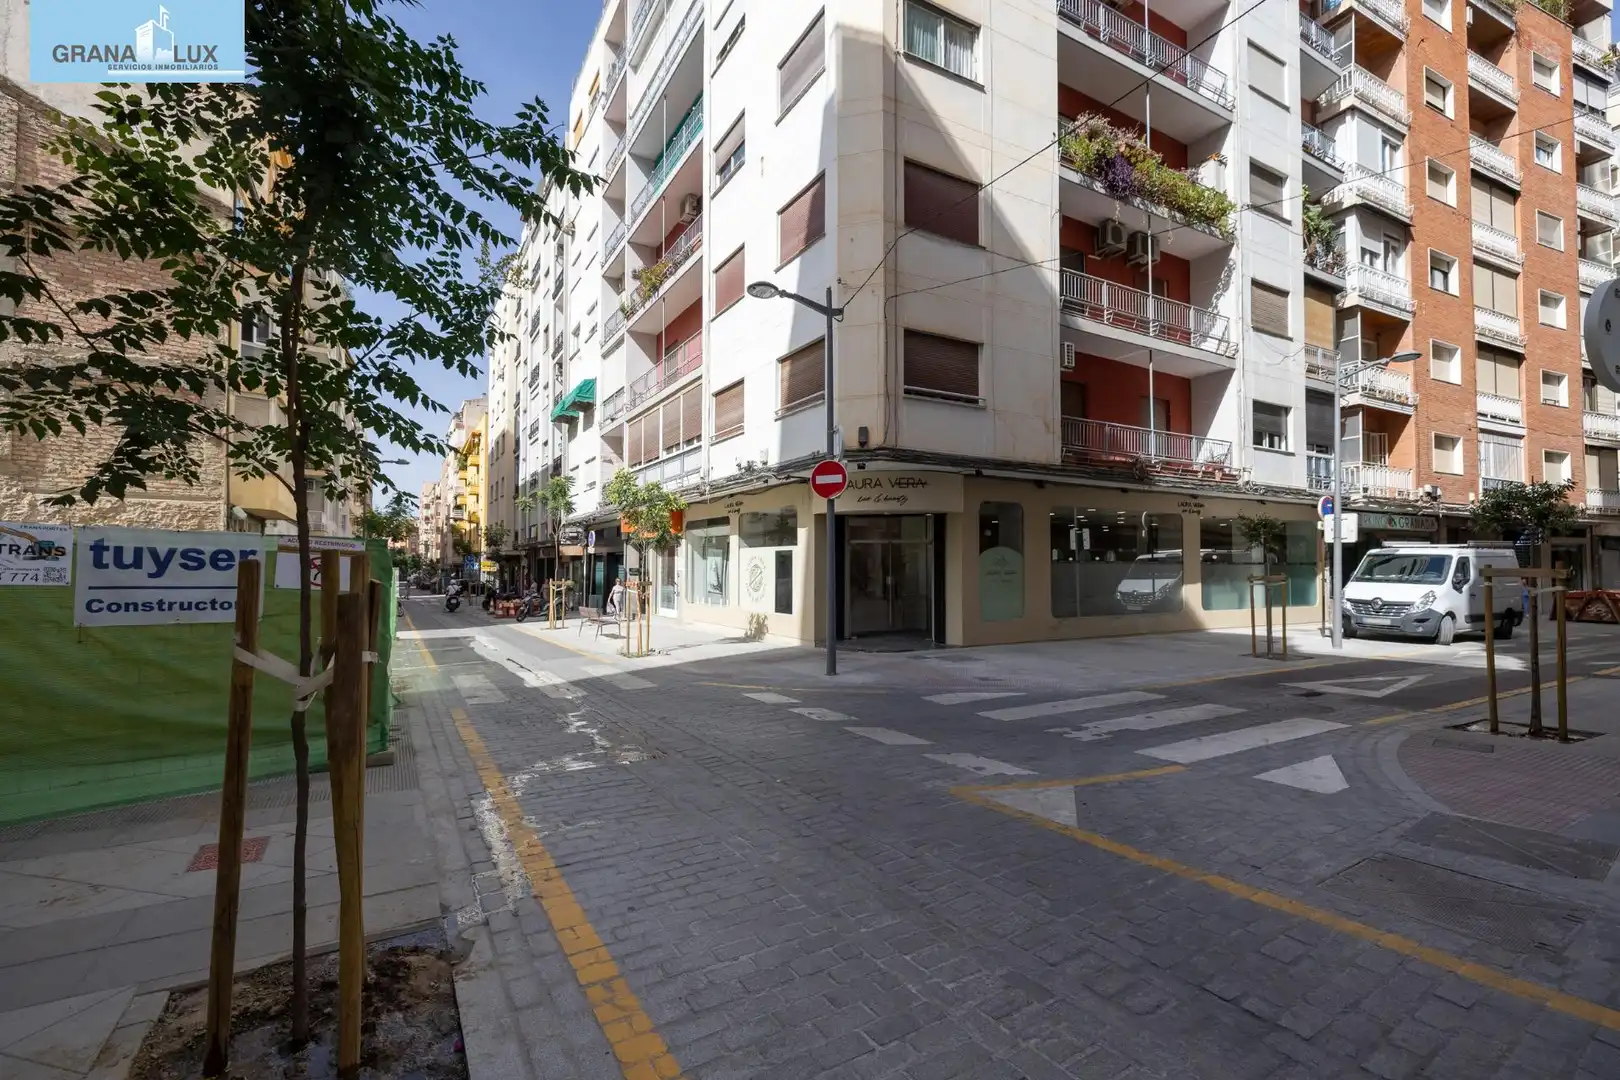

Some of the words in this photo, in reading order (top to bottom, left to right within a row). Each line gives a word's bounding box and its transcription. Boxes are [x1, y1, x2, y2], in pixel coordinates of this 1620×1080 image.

[847, 476, 884, 490] AURA
[888, 476, 927, 489] VERA
[89, 537, 259, 579] tuyser
[85, 597, 237, 614] Constructo
